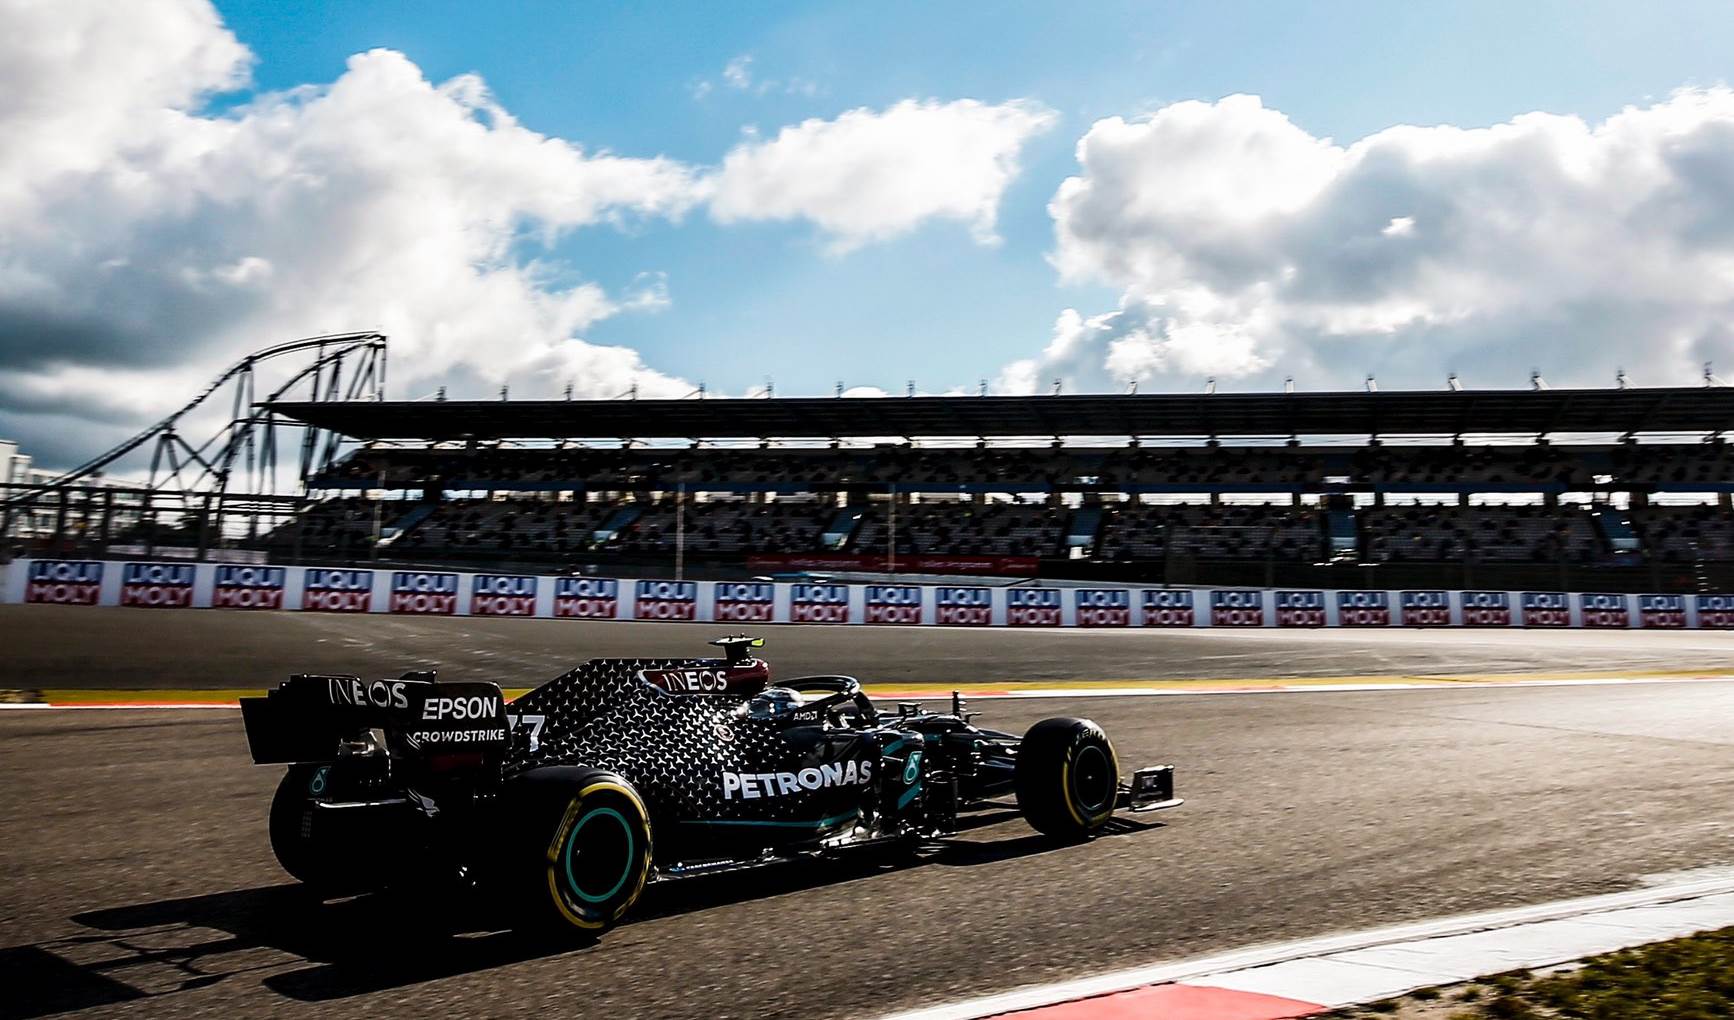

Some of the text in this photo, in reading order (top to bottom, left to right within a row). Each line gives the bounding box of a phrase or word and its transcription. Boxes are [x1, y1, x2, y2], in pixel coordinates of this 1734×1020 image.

[29, 564, 103, 581] LIQUI
[123, 565, 195, 584] LIQUI
[216, 568, 285, 586] LIQUI
[307, 571, 372, 589] LIQUI
[394, 574, 457, 592] LIQUI
[475, 577, 536, 594] LIQUI
[557, 580, 617, 596] LIQUI
[637, 582, 697, 599] LIQUI
[26, 584, 99, 602] MOLY
[121, 587, 193, 604] MOLY
[216, 589, 282, 607] MOLY
[716, 584, 774, 600] LIQUI
[792, 586, 847, 601] LIQUI
[866, 588, 920, 603] LIQUI
[937, 589, 991, 605] LIQUI
[1008, 590, 1060, 605] LIQUI
[1076, 591, 1128, 606] LIQUI
[1143, 592, 1191, 606] LIQUI
[1211, 592, 1261, 607] LIQUI
[1276, 593, 1324, 607] LIQUI
[1338, 593, 1387, 607] LIQUI
[305, 592, 370, 609] MOLY
[392, 594, 456, 611] MOLY
[473, 597, 535, 614] MOLY
[556, 599, 616, 616] MOLY
[636, 602, 695, 619] MOLY
[715, 603, 773, 620] MOLY
[792, 605, 848, 621] MOLY
[866, 606, 920, 622] MOLY
[937, 607, 991, 623] MOLY
[1008, 608, 1060, 624] MOLY
[1077, 609, 1129, 625] MOLY
[1143, 610, 1192, 625] MOLY
[1212, 610, 1262, 625] MOLY
[1277, 610, 1325, 625] MOLY
[1340, 610, 1389, 625] MOLY
[662, 671, 728, 692] INEOS
[328, 678, 408, 708] INEOS
[422, 697, 498, 720] EPSON
[412, 729, 505, 744] CROWDSTRIKE
[722, 760, 872, 800] PETRONAS
